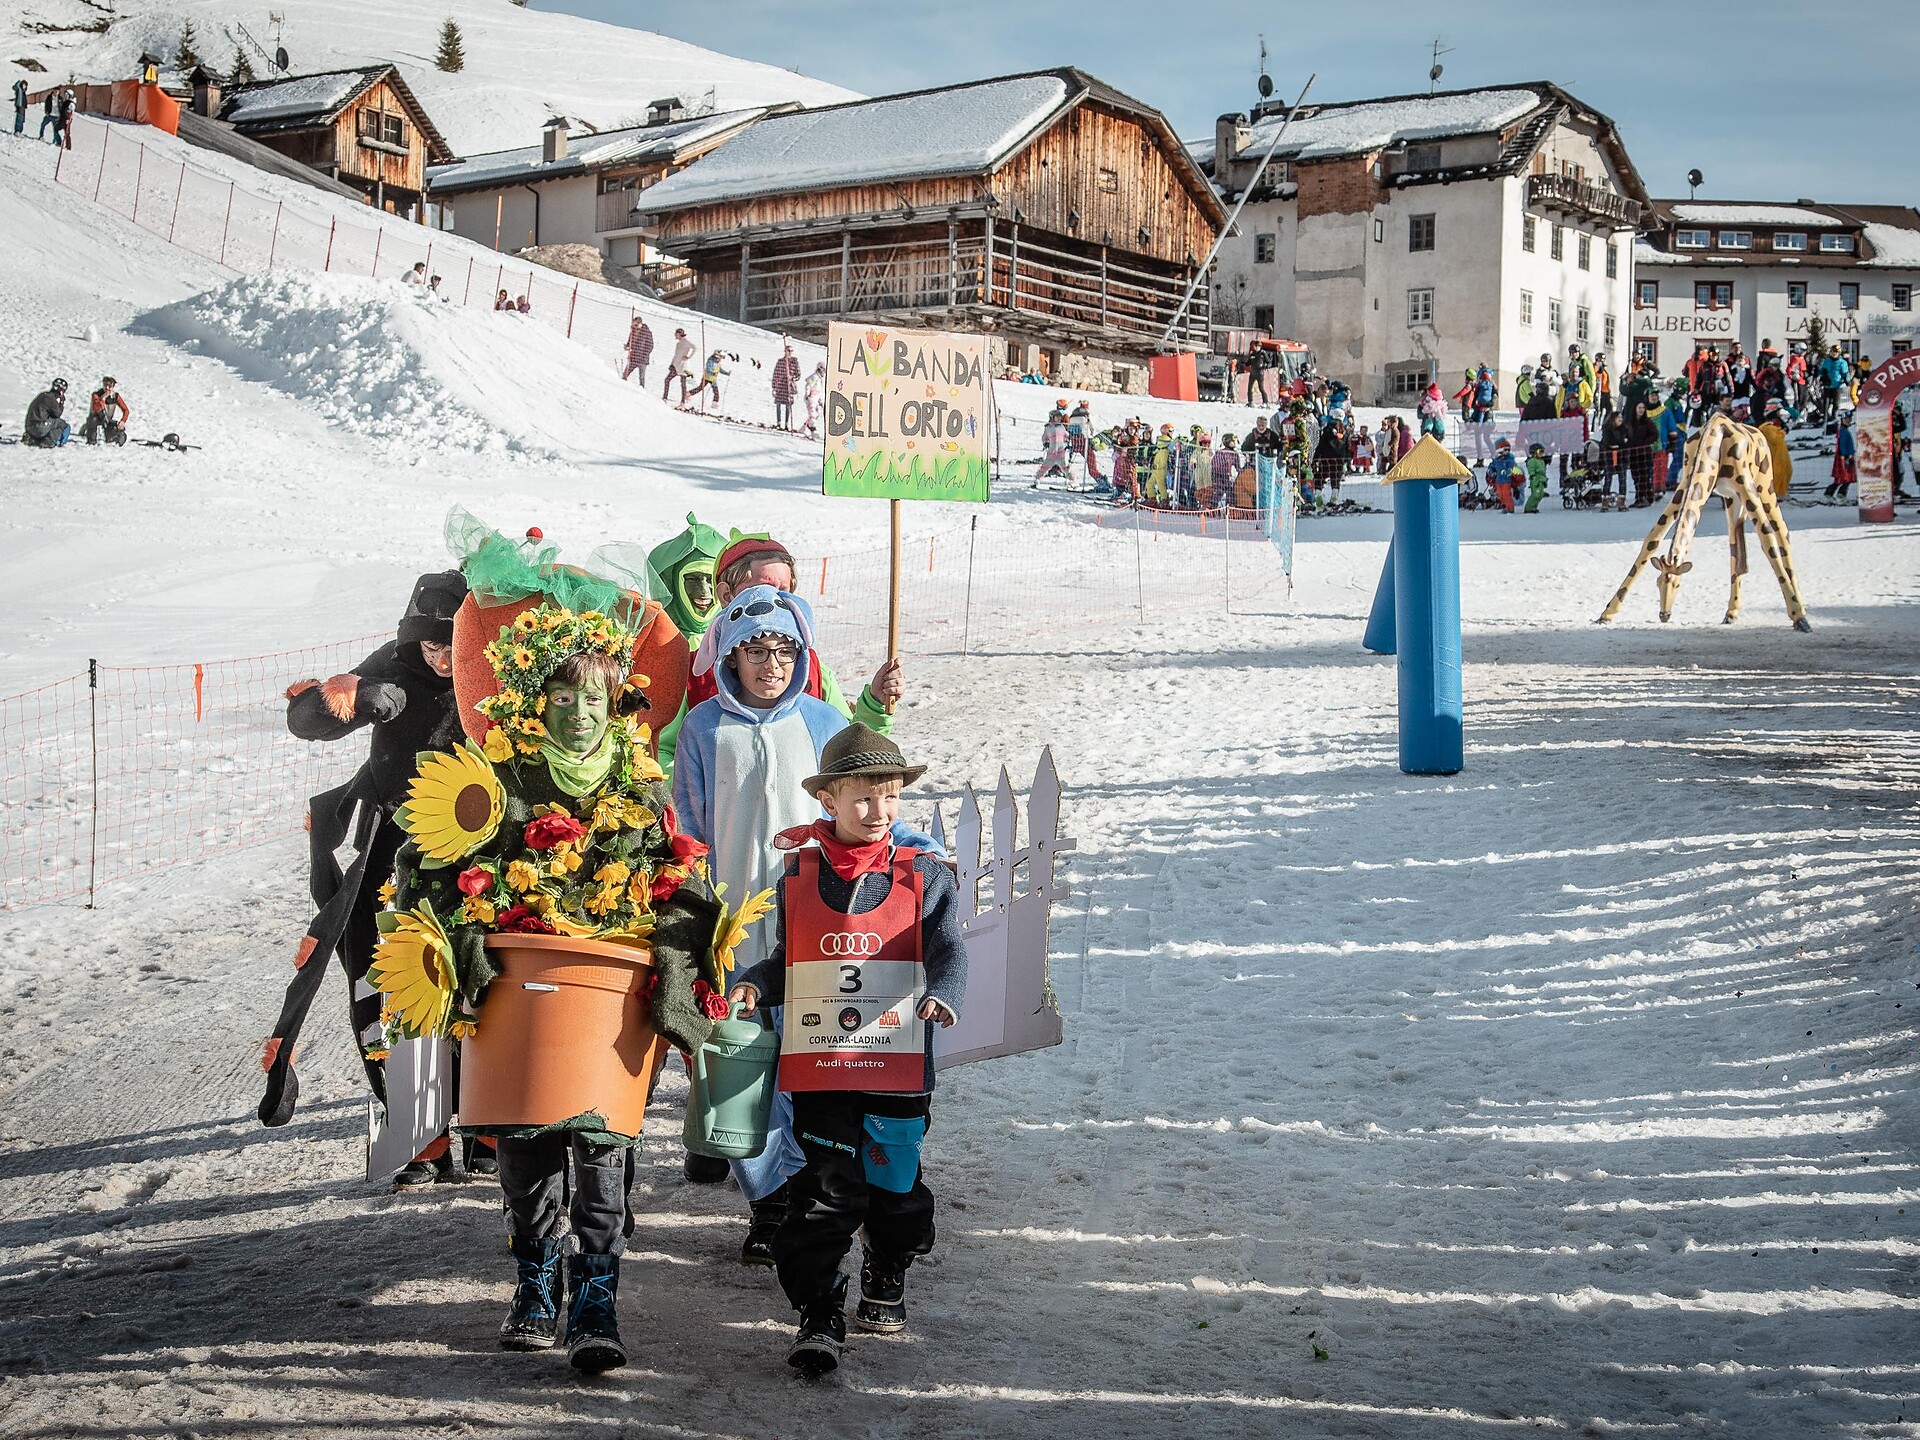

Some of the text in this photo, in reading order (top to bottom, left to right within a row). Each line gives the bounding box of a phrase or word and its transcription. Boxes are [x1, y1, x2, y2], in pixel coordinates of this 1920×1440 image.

[1868, 313, 1888, 323] BAR
[1641, 315, 1731, 332] ALBERGO
[838, 337, 984, 391] LA BANDA
[839, 964, 863, 994] 3
[882, 1010, 898, 1018] ALTA
[809, 1036, 891, 1044] CORVARA-LADINIA
[815, 1059, 885, 1069] Audi quattro
